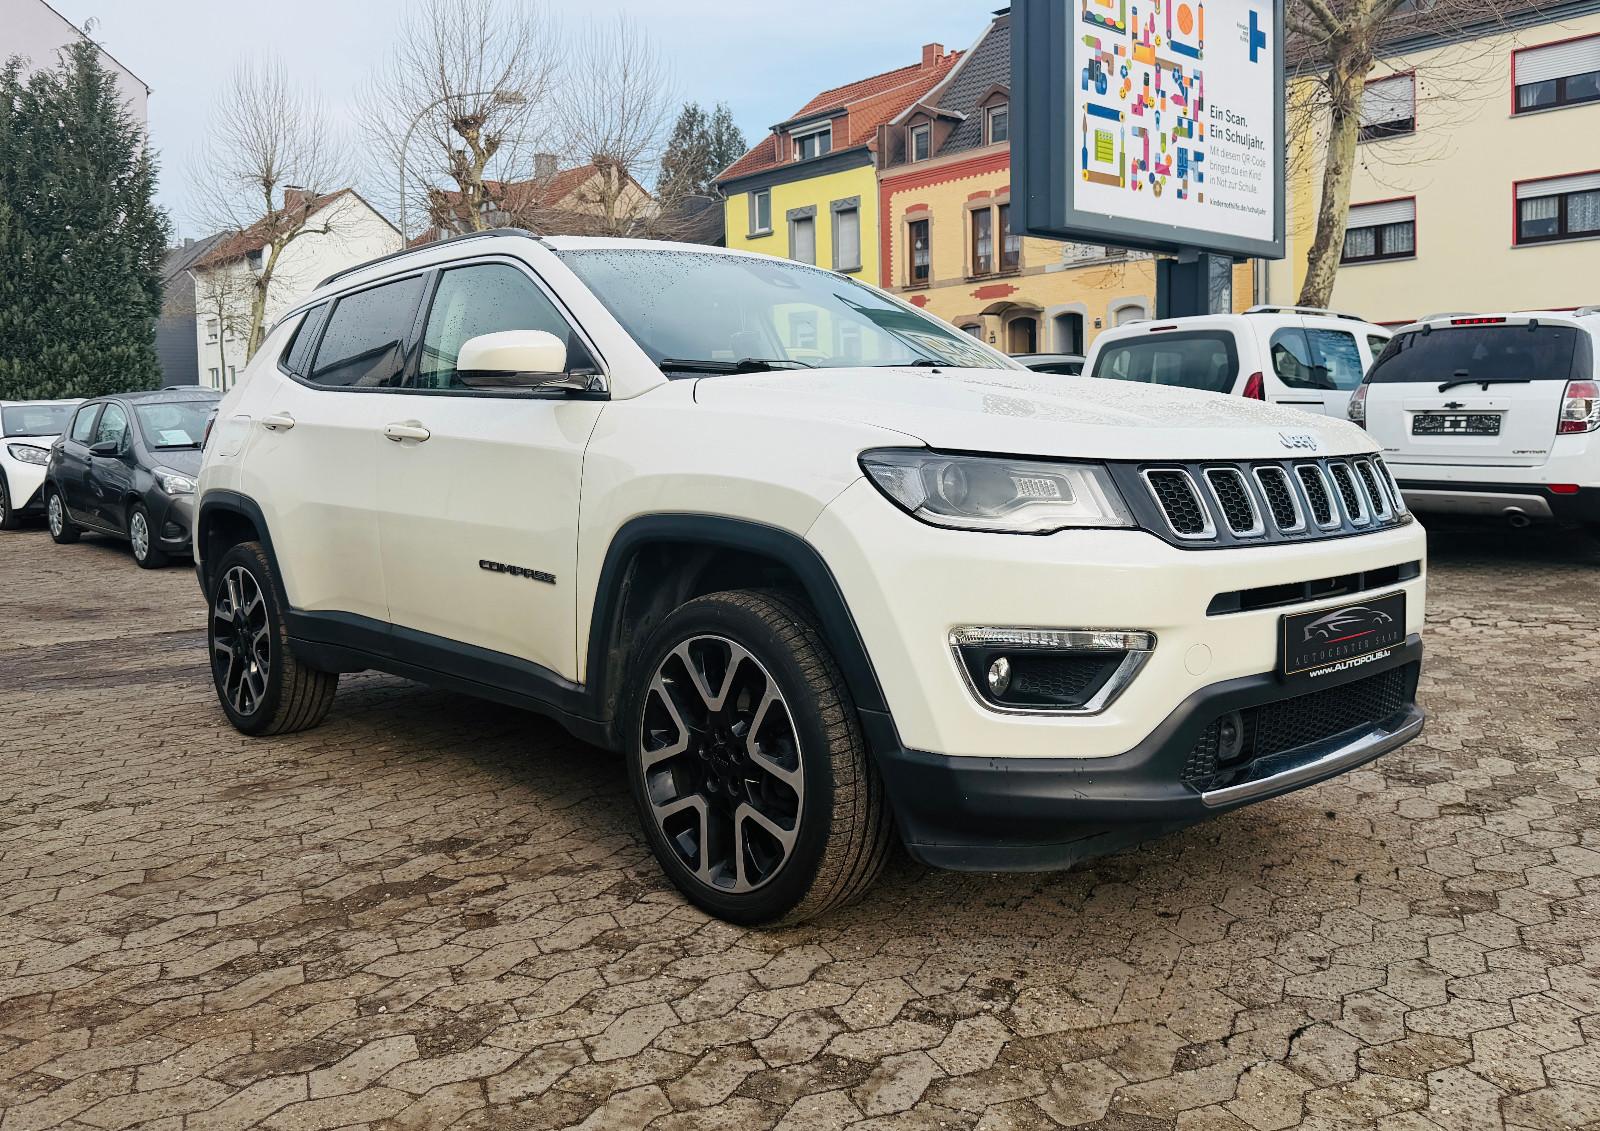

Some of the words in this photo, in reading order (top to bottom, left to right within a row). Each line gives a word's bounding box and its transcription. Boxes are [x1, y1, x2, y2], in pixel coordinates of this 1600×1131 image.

[1210, 104, 1223, 121] Ein
[1225, 109, 1248, 128] Scan.
[1210, 123, 1223, 140] Ein
[1225, 128, 1265, 151] Schuljahr.
[1210, 145, 1219, 157] Mit
[1220, 148, 1241, 161] diesem
[1209, 160, 1230, 175] bringst
[1231, 164, 1239, 176] du
[1239, 168, 1248, 177] ein
[1248, 169, 1262, 181] Kind
[1209, 175, 1216, 185] in
[1216, 176, 1227, 188] Not
[1228, 181, 1238, 190] zur
[1278, 431, 1318, 451] Jeep
[478, 559, 557, 585] COMPASS
[1295, 639, 1369, 666] AUTOCENTER
[1375, 631, 1398, 645] SAAR
[1309, 649, 1391, 678] www.AUTOPOLIS.lu
